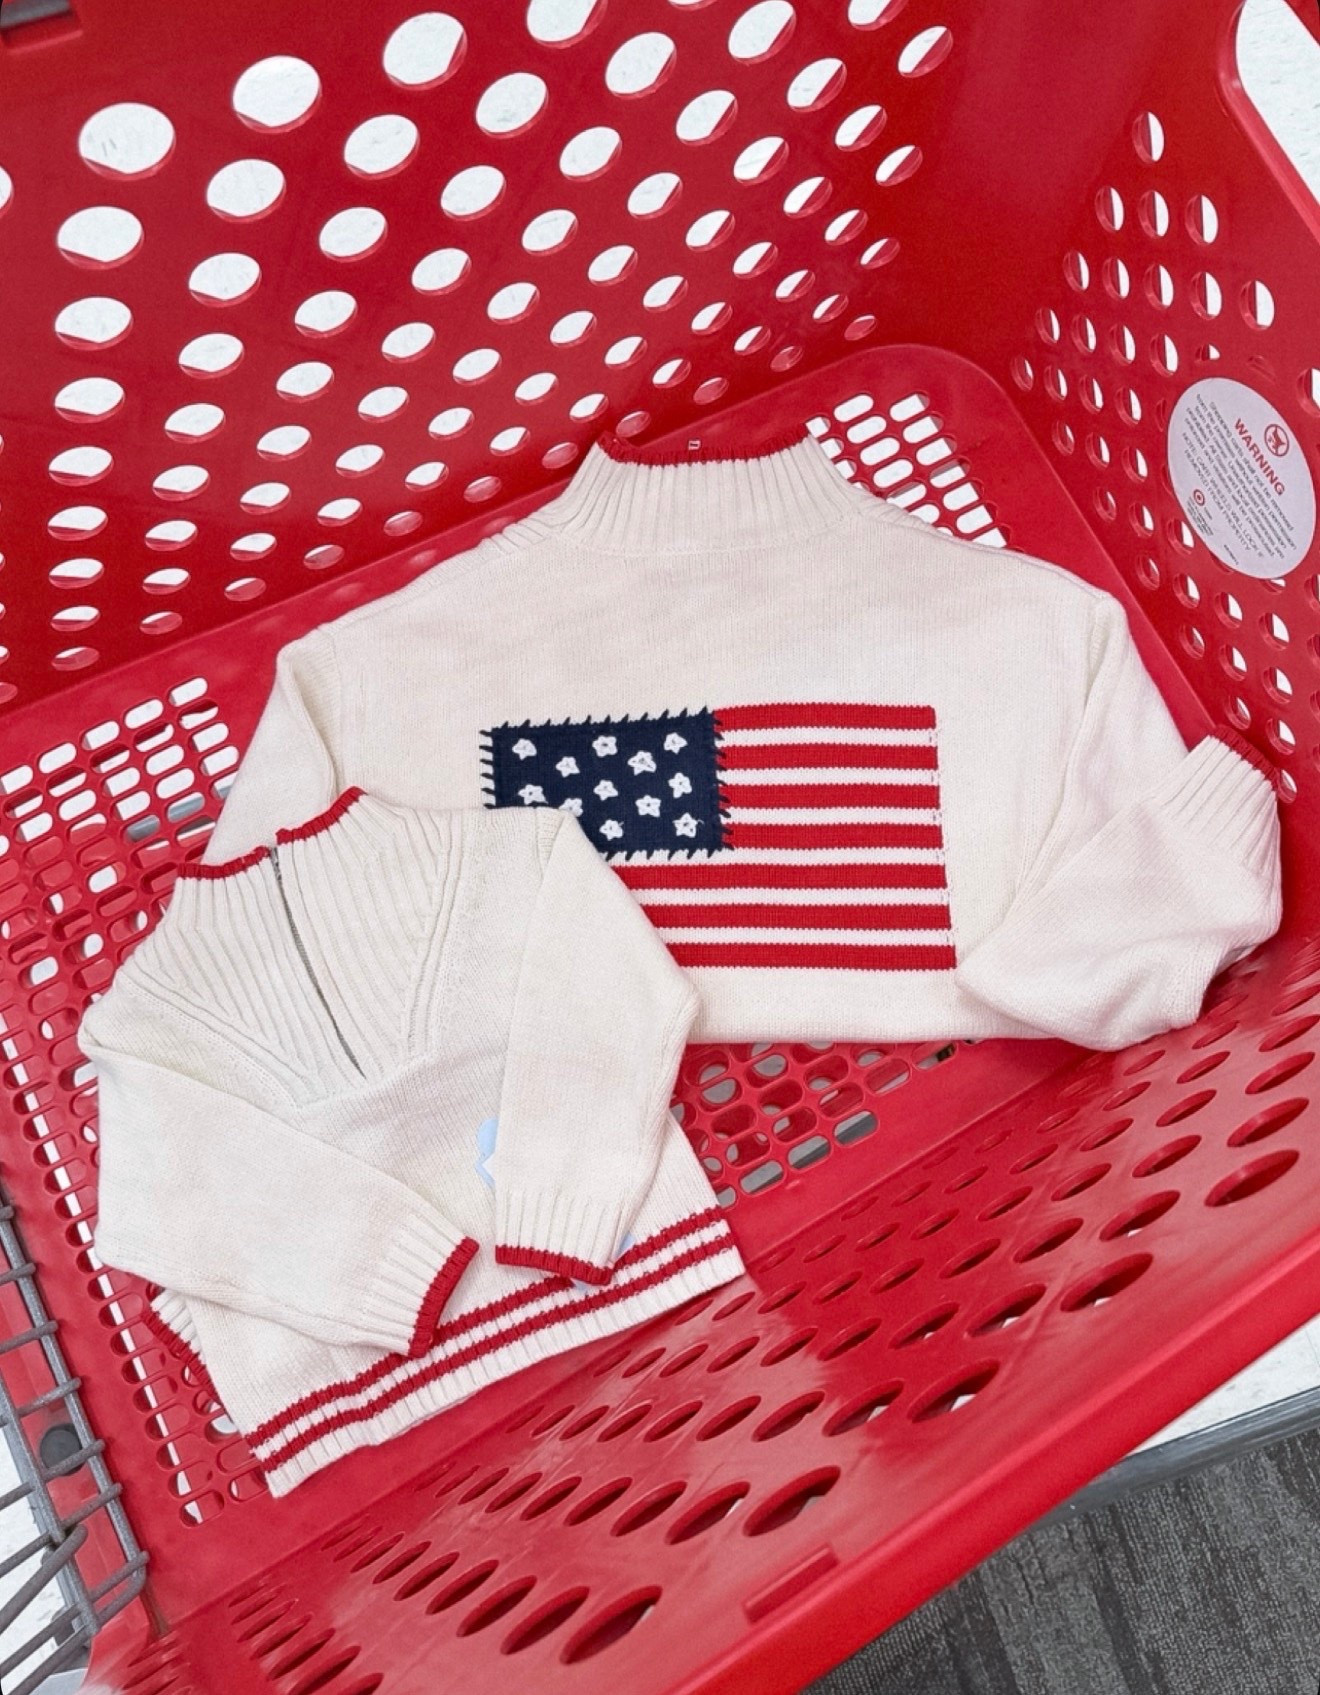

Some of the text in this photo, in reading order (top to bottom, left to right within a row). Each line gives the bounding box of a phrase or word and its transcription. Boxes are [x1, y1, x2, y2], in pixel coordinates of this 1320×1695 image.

[1212, 424, 1236, 458] premises
[1233, 458, 1254, 485] without
[1251, 485, 1270, 510] written
[1267, 510, 1297, 551] permission
[1229, 437, 1245, 457] carts
[1242, 456, 1256, 474] shall
[1269, 498, 1294, 531] removed
[1232, 418, 1286, 495] WARNING
[1236, 489, 1250, 506] local
